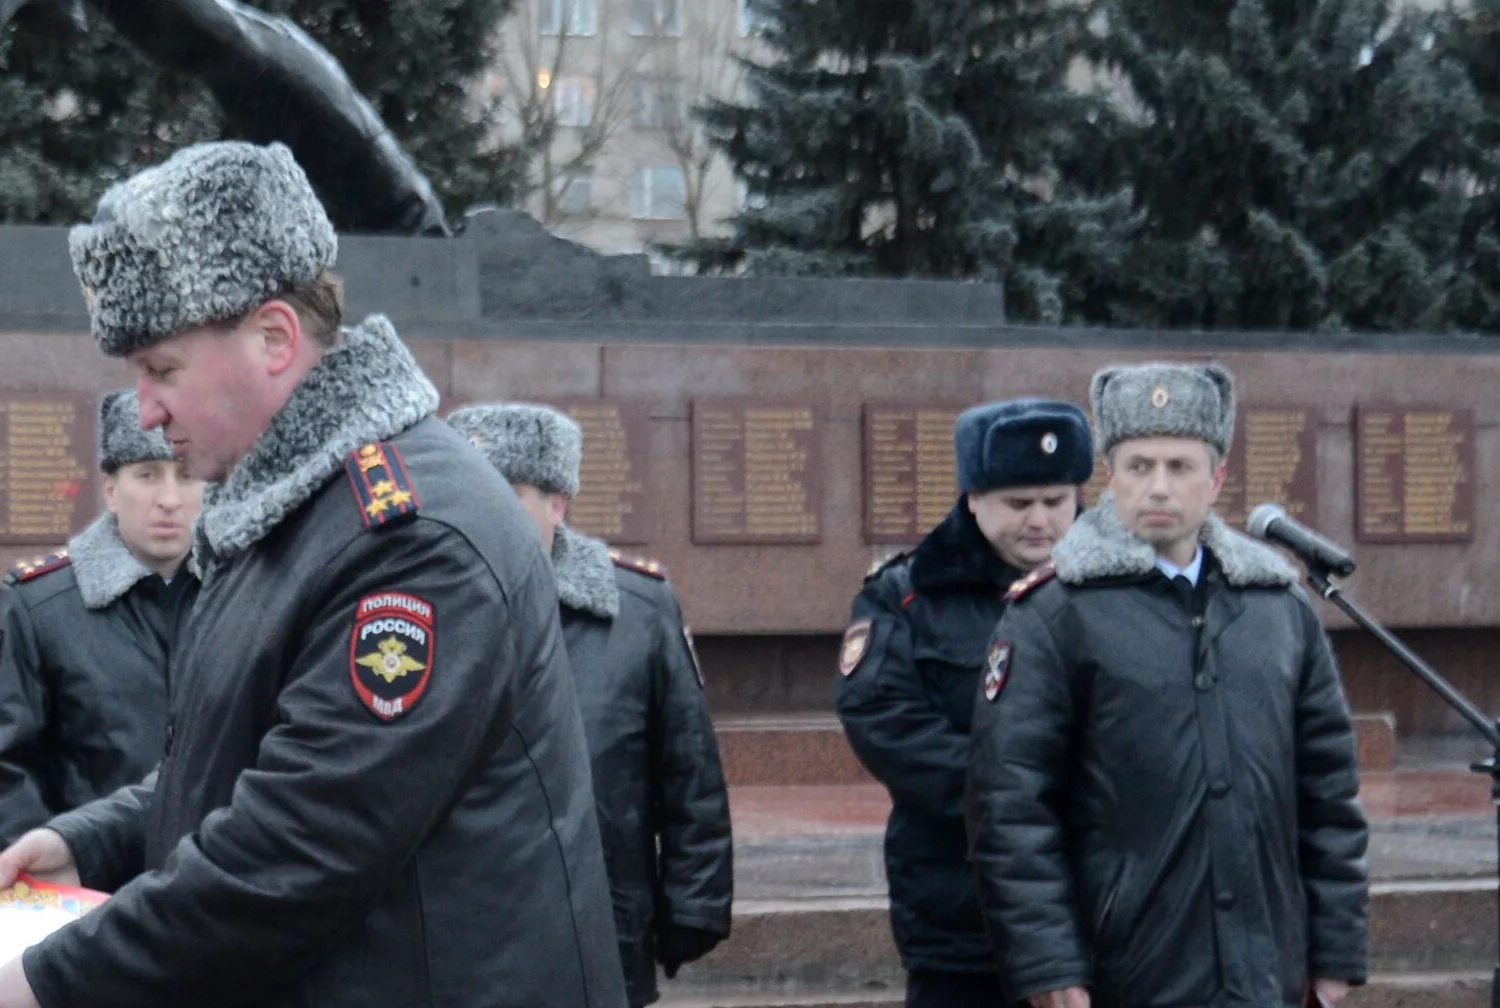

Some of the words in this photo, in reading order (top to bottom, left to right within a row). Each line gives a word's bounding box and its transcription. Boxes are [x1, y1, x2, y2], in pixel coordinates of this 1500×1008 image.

[362, 596, 431, 618] ПОЛИЦИЯ
[360, 619, 426, 646] РОССИЯ
[372, 695, 404, 717] МВД
